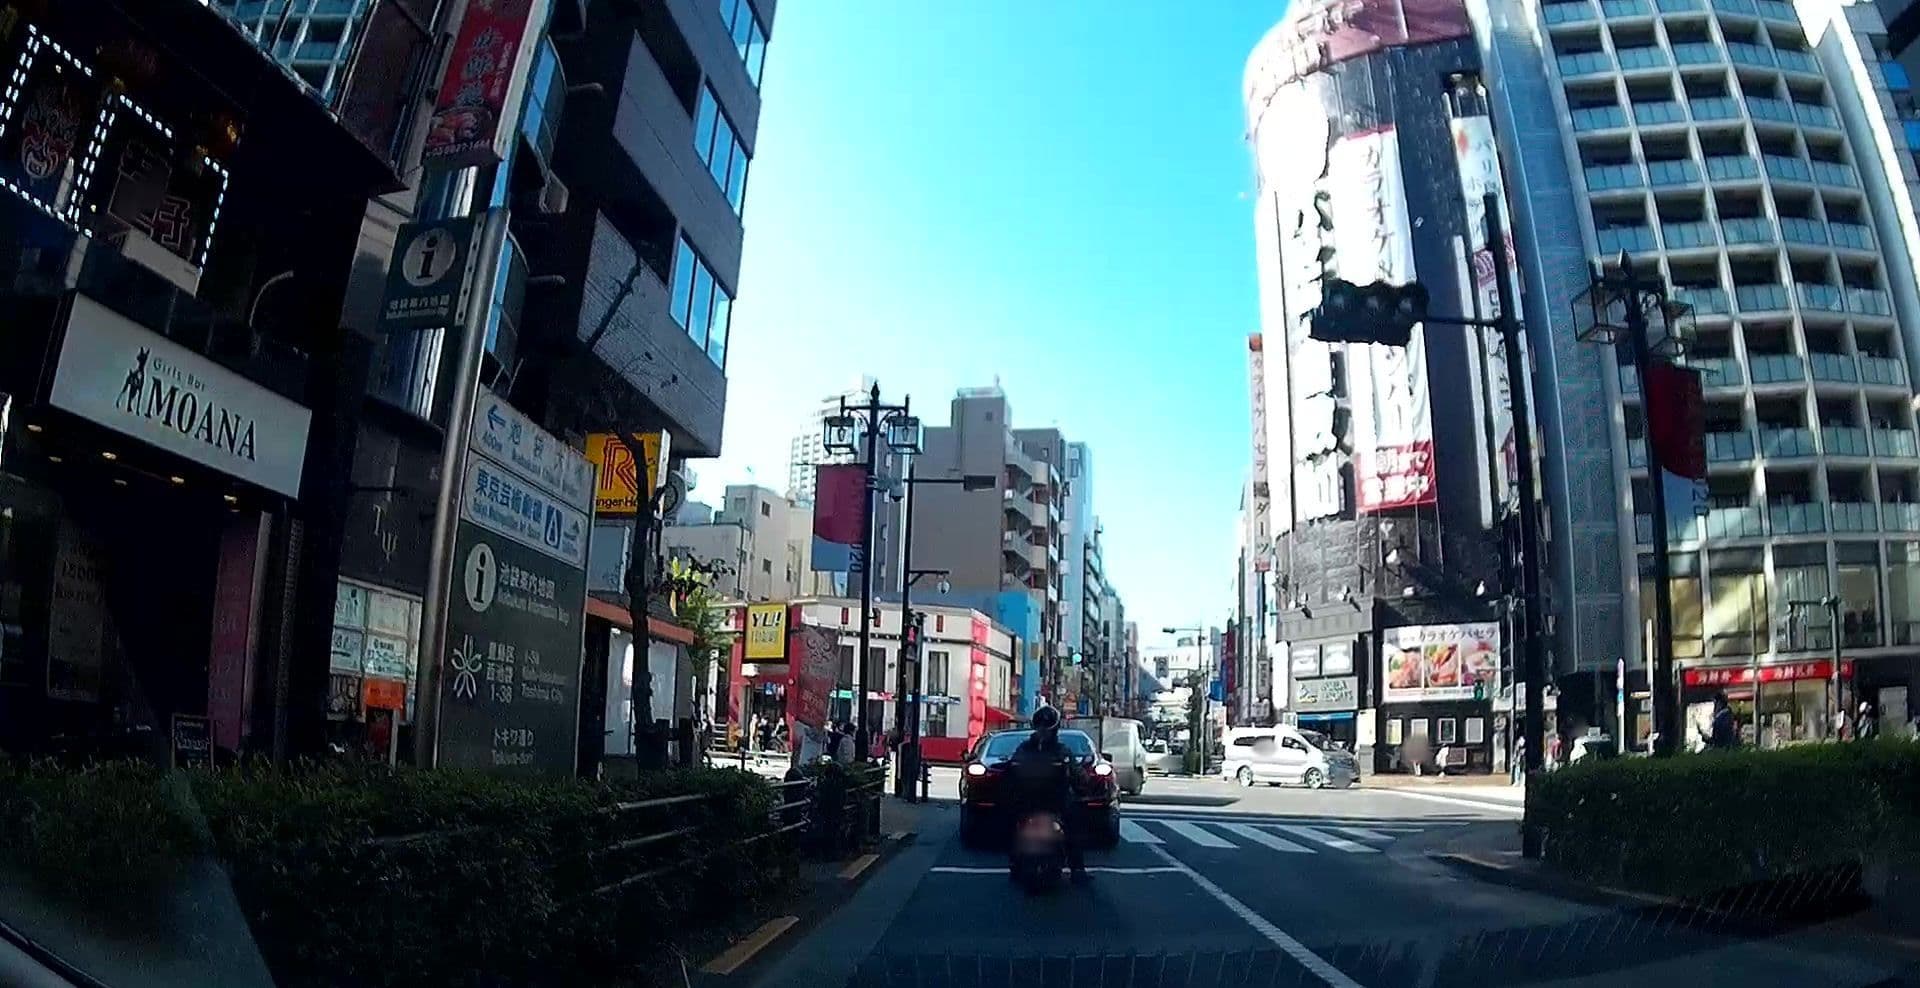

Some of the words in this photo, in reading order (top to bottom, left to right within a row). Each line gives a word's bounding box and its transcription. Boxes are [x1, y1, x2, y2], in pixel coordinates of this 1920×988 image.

[144, 375, 256, 462] MOANA
[499, 561, 555, 601] 池袋案内地図
[494, 727, 535, 748] トキワ通り
